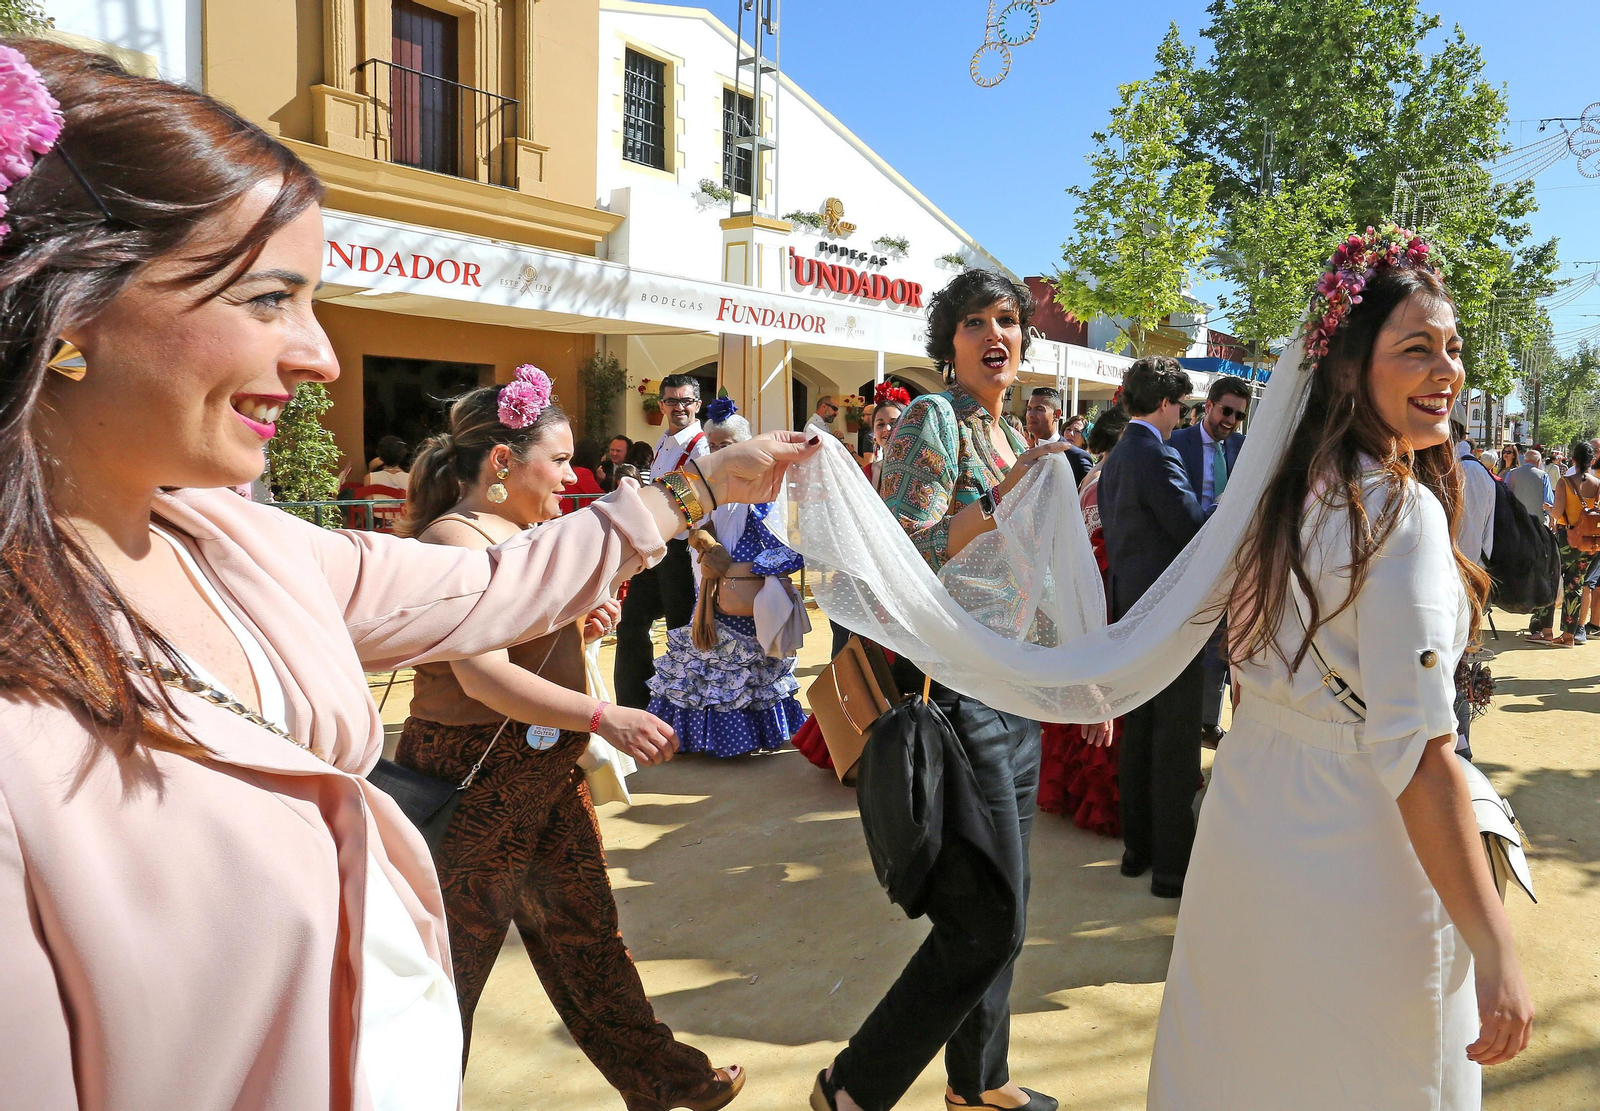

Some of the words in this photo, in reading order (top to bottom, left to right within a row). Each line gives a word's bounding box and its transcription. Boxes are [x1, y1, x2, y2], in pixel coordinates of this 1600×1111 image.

[324, 239, 482, 288] NDADOR
[819, 241, 888, 267] BODEGAS
[535, 284, 552, 292] 1730
[641, 293, 703, 311] BODEGAS
[716, 297, 826, 334] FUNDADOR
[1096, 360, 1125, 379] FUNDA
